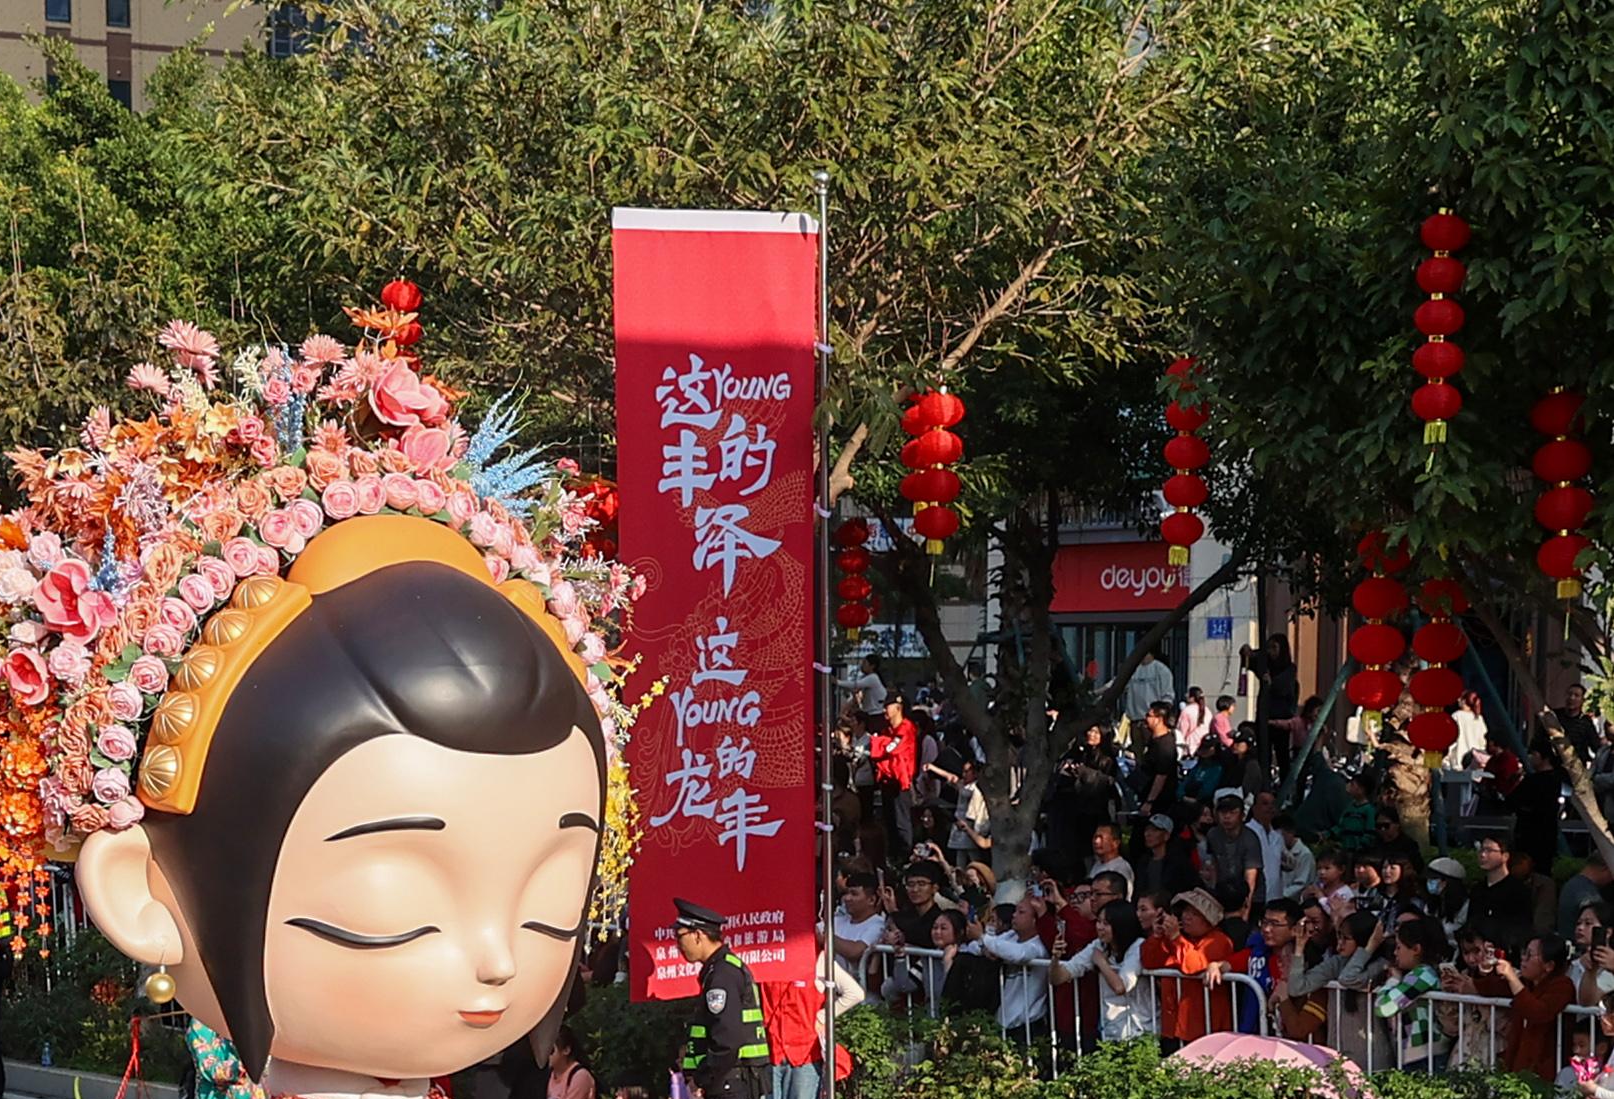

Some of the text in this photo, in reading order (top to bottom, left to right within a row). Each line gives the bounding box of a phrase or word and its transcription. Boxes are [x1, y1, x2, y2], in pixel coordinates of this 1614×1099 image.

[655, 353, 722, 428] 这
[712, 363, 791, 407] YOUNG
[719, 414, 776, 496] 的
[692, 616, 748, 686] 这
[669, 685, 762, 747] YOUNG
[715, 735, 757, 780] 的
